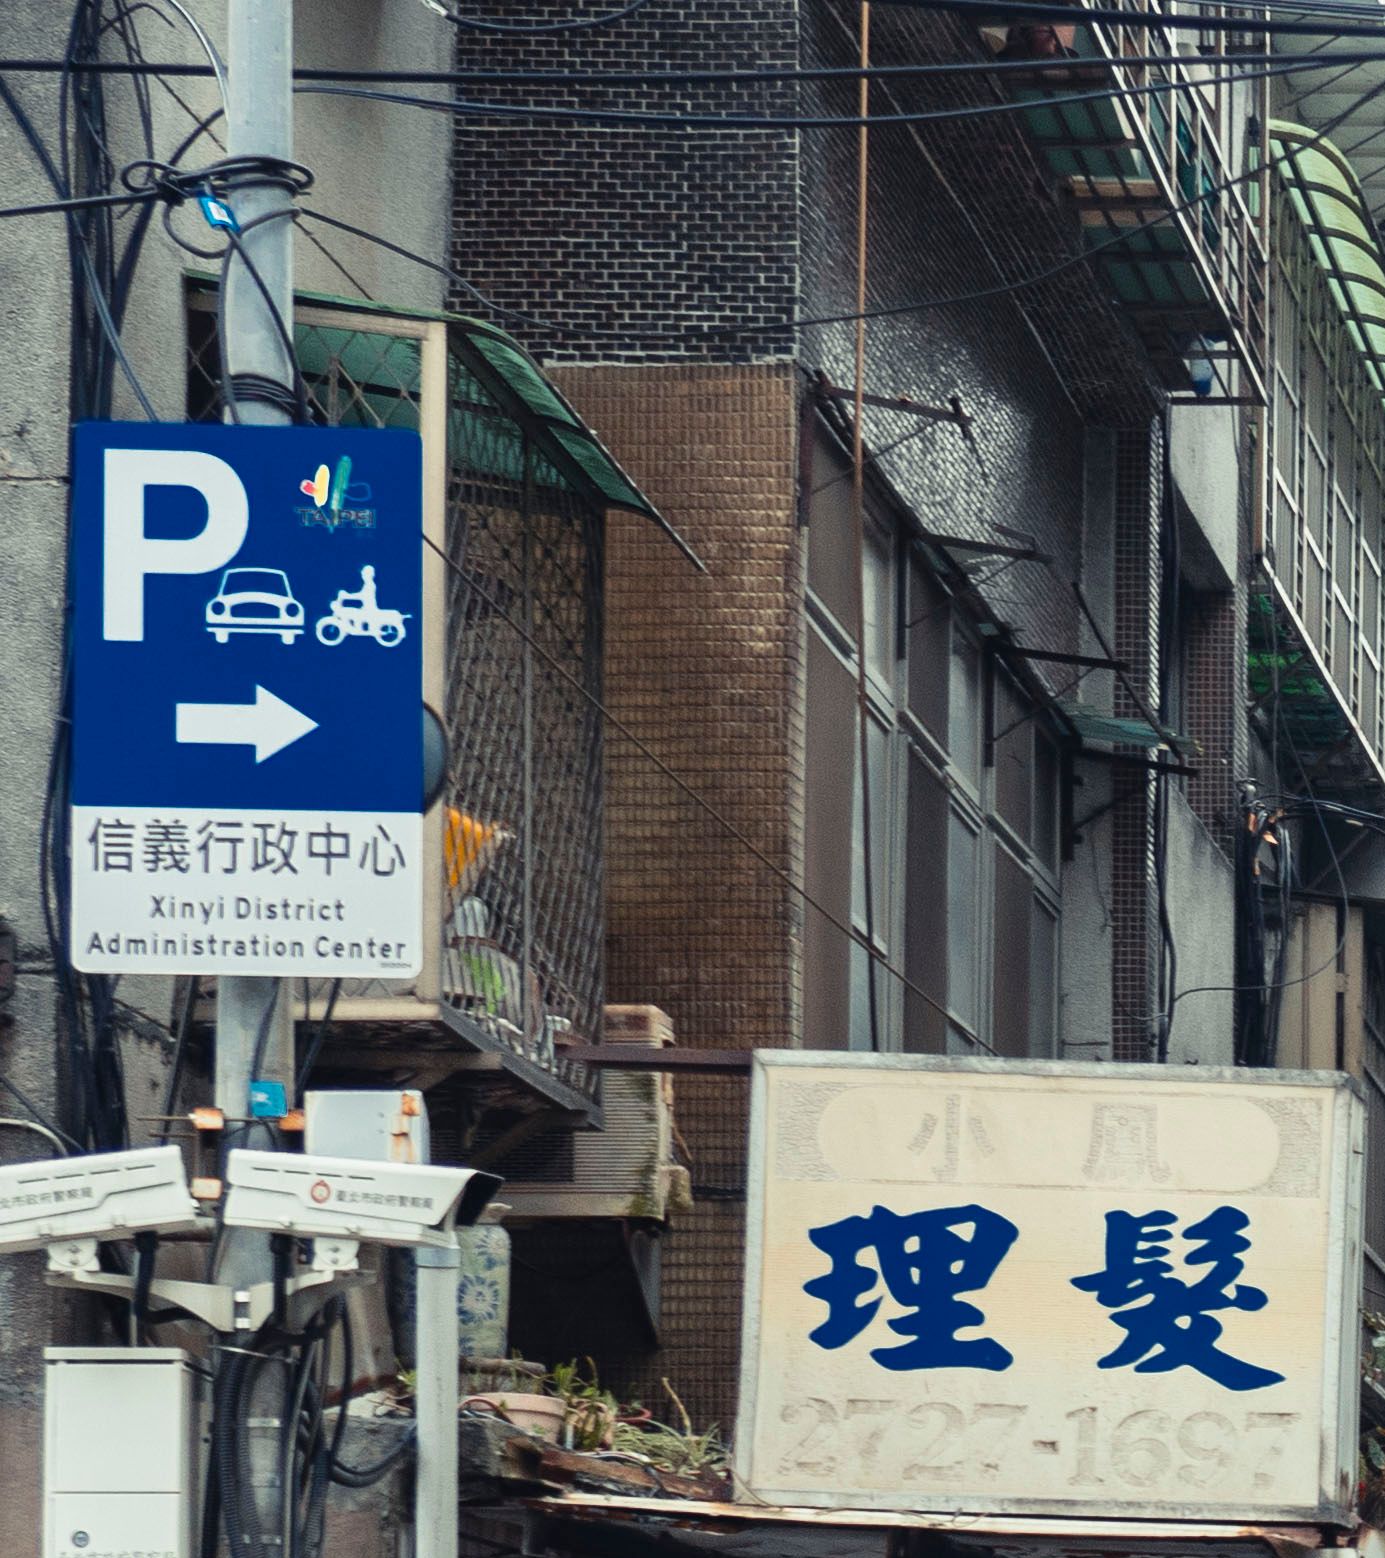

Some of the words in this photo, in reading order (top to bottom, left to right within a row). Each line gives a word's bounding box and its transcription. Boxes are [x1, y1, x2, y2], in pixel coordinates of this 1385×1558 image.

[103, 448, 249, 642] P
[87, 817, 406, 878] 信義行政中心
[87, 931, 305, 958] Administration
[314, 936, 407, 961] Center
[149, 895, 225, 925] Xinyi
[235, 897, 346, 922] District
[802, 1203, 1286, 1391] 理髮
[777, 1396, 1303, 1489] 2727-1697
